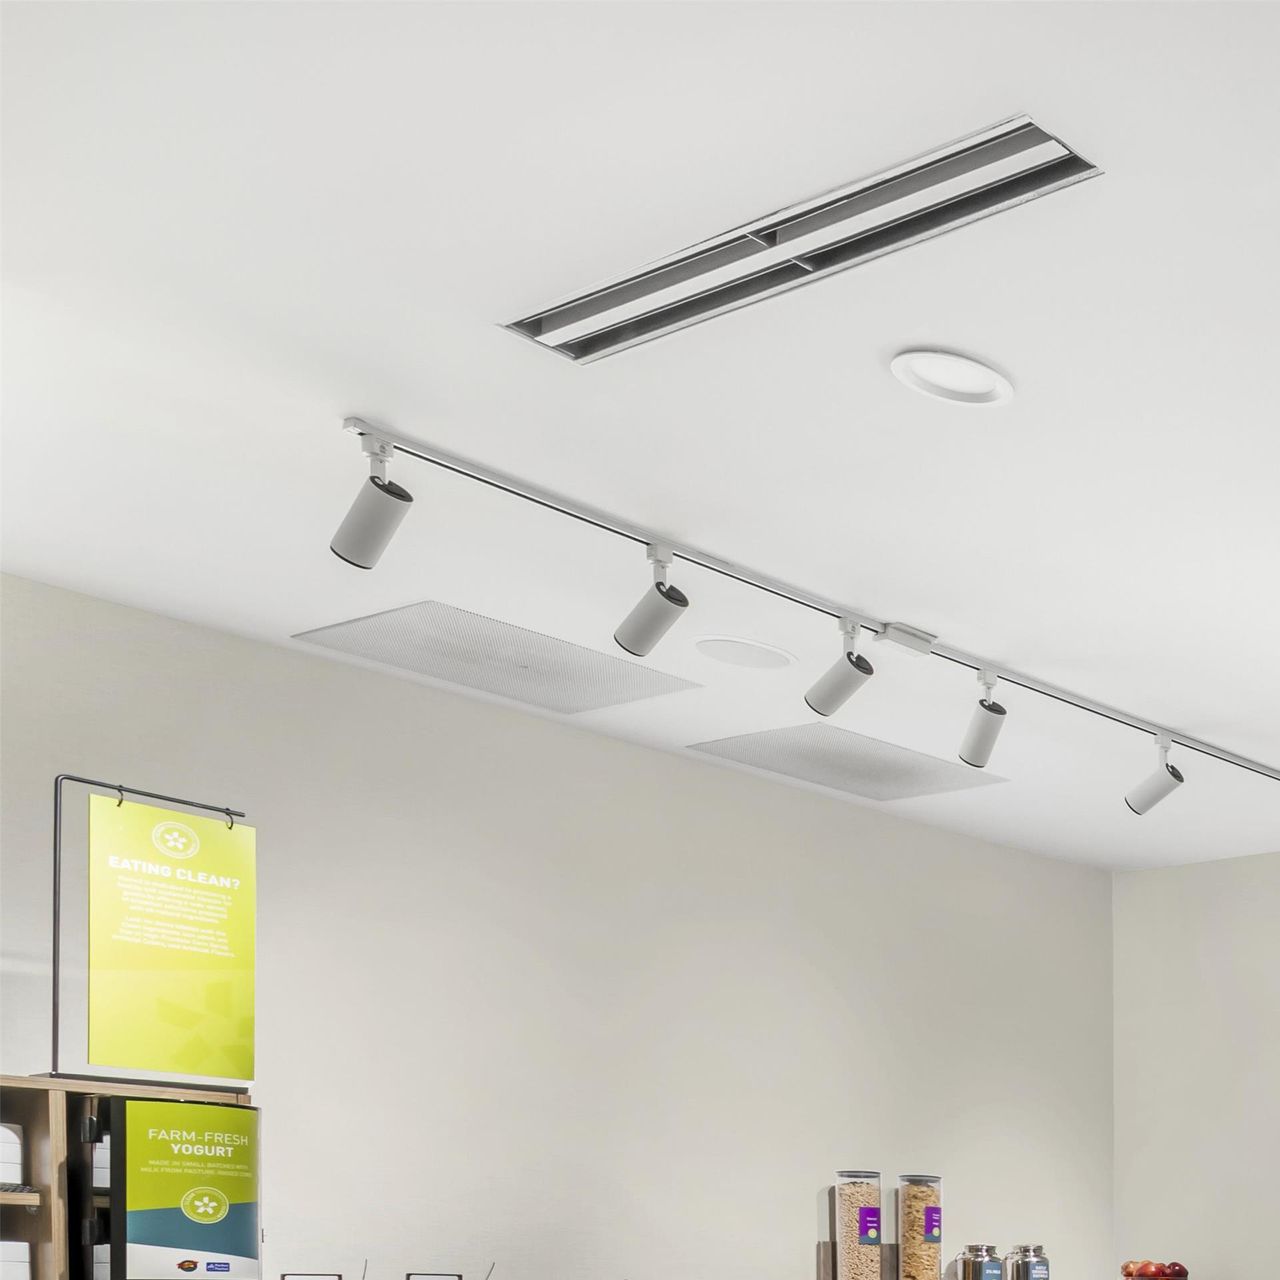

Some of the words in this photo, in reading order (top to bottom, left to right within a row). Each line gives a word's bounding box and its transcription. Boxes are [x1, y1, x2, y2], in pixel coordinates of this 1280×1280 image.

[108, 855, 172, 878] EATING
[175, 867, 241, 890] CLEAN?
[148, 1128, 249, 1147] FARM-FRESH
[170, 1143, 234, 1157] YOGURT
